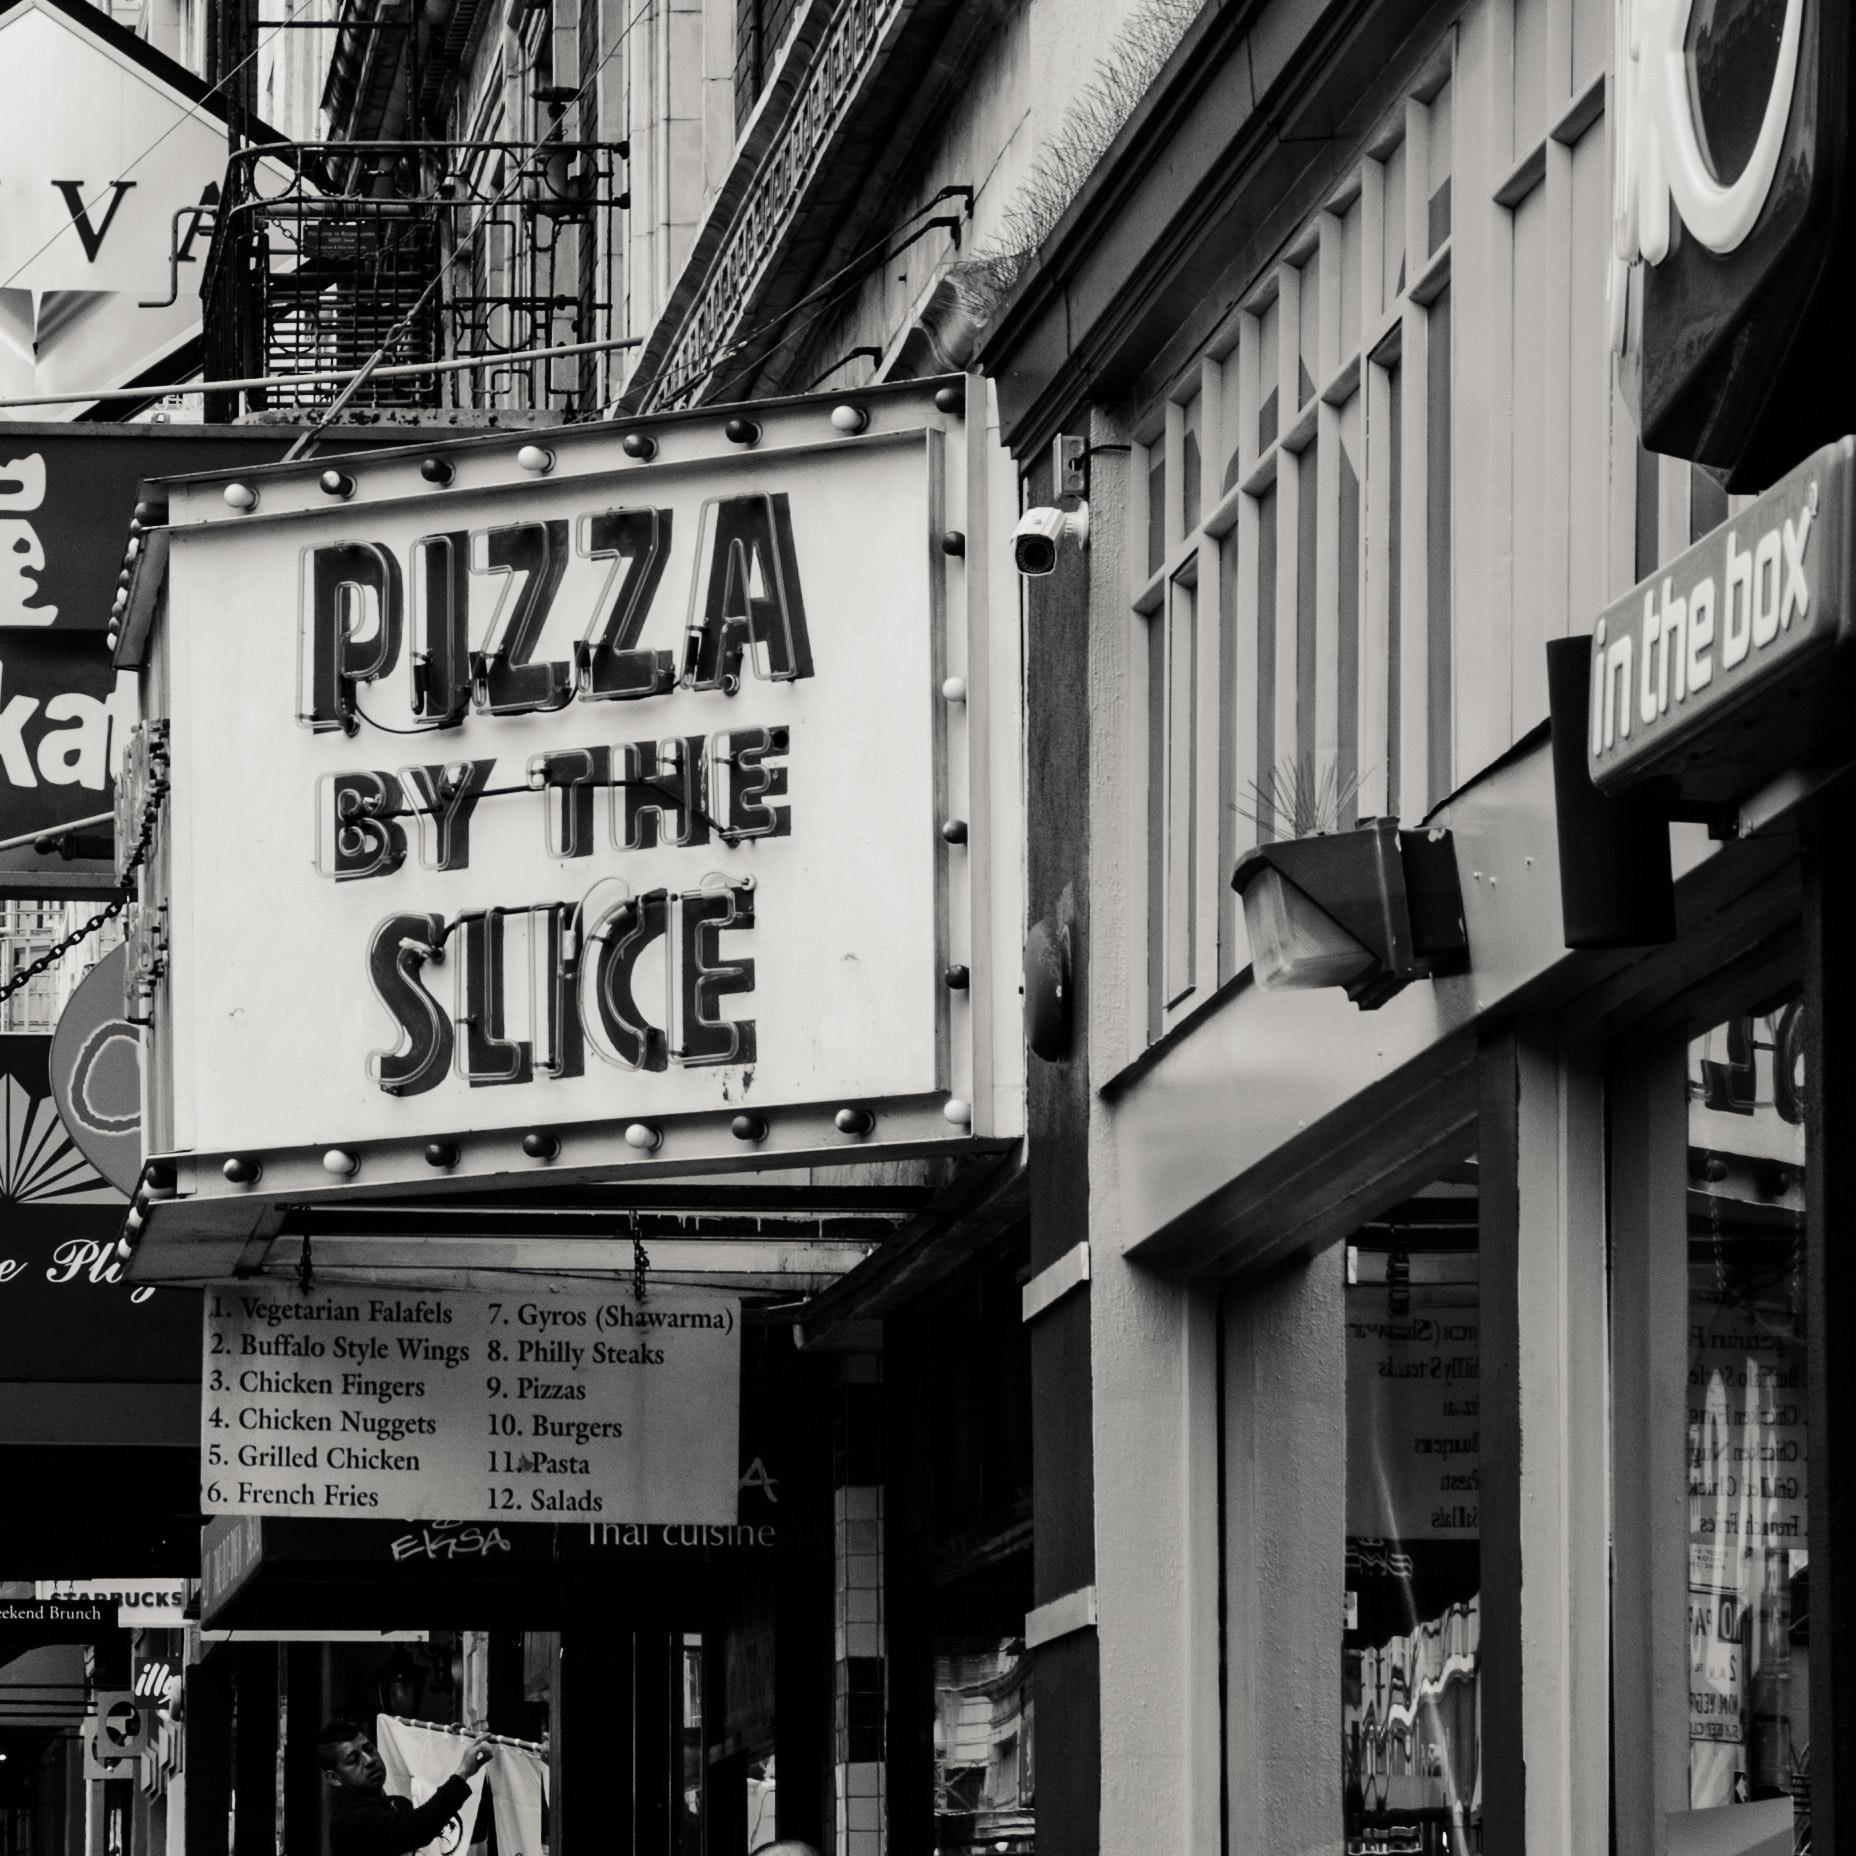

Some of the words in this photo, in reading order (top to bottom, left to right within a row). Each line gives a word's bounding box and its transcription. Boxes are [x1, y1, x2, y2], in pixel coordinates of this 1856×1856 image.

[295, 490, 813, 734] PIZZA
[1595, 617, 1633, 756] in
[1640, 576, 1715, 725] the
[1722, 505, 1811, 672] box
[315, 756, 497, 884] BY
[526, 724, 792, 861] THE
[365, 879, 758, 1097] SLICE
[241, 1296, 361, 1328] Vegetarian
[367, 1300, 454, 1325] Falafels
[487, 1302, 510, 1326] 7.
[517, 1303, 587, 1334] Gyros
[595, 1304, 734, 1336] (Shawarma)
[209, 1332, 232, 1355] 2.
[240, 1333, 326, 1358] Buffalo
[332, 1336, 390, 1366] Style
[395, 1337, 470, 1370] Wings
[487, 1339, 509, 1362] 8.
[517, 1340, 586, 1371] Philly
[591, 1341, 665, 1366] Steaks
[209, 1369, 232, 1392] 3.
[239, 1370, 334, 1395] Chicken
[341, 1372, 427, 1404] Fingers
[485, 1375, 509, 1400] 9.
[516, 1376, 587, 1401] Pizzas
[207, 1407, 230, 1429] 4.
[237, 1407, 332, 1432] Chicken
[339, 1410, 437, 1442] Nuggets
[487, 1413, 523, 1437] 10.
[531, 1414, 623, 1445] Burgers
[207, 1443, 230, 1466] 5.
[237, 1444, 318, 1469] Grilled
[325, 1446, 421, 1472] Chicken
[487, 1450, 523, 1474] 11.
[531, 1450, 591, 1475] Pasta
[206, 1481, 229, 1504] 6.
[237, 1481, 316, 1506] French
[324, 1484, 379, 1507] Fries
[487, 1487, 523, 1511] 12.
[530, 1488, 604, 1512] Salads
[49, 1605, 102, 1621] Brunch
